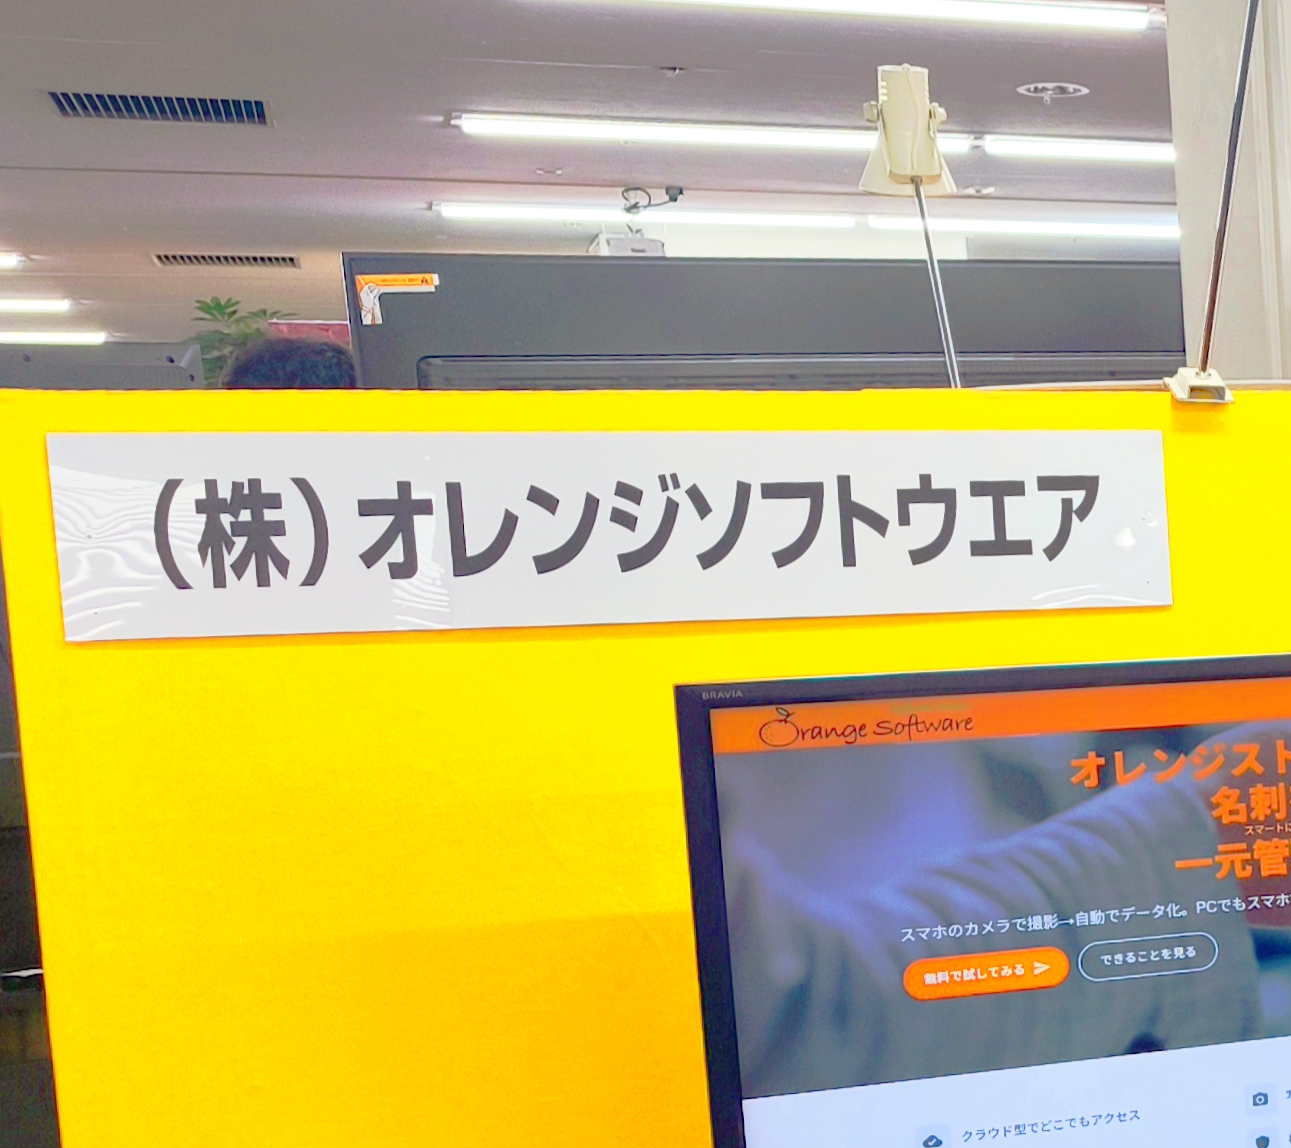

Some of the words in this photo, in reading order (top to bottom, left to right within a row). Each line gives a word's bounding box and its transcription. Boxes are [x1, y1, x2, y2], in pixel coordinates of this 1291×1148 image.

[702, 690, 744, 701] BRAVIA
[872, 712, 974, 740] Software
[1100, 944, 1197, 967] できることを見る
[923, 961, 1025, 986] 無料で試してみる
[961, 1109, 1141, 1144] クラウド型でどこでもアクセス
